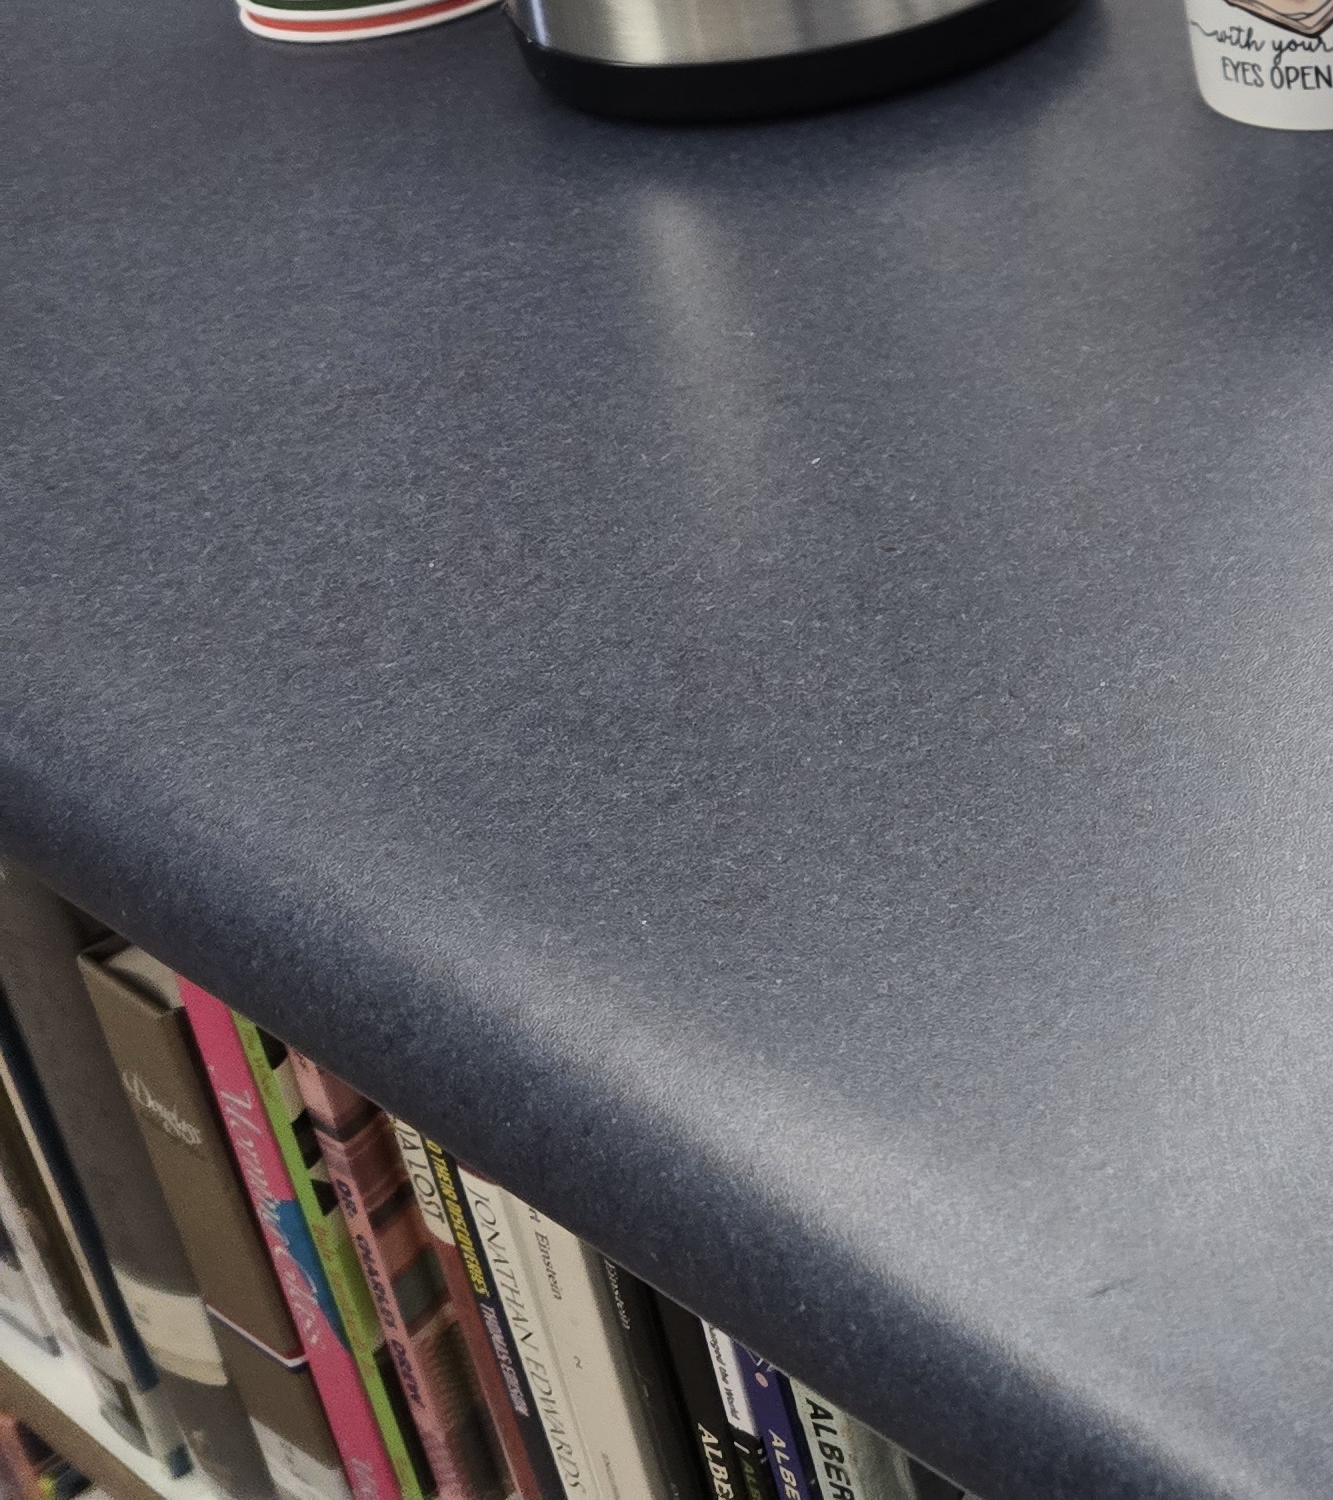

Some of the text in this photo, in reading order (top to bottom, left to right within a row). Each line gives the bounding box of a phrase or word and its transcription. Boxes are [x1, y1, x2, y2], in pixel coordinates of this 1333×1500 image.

[1207, 25, 1265, 53] with
[1222, 55, 1333, 90] EYES OPEN
[411, 1163, 447, 1226] LOST
[535, 1231, 563, 1301] Einstein
[465, 1186, 587, 1495] JONATHAN EDWARDS
